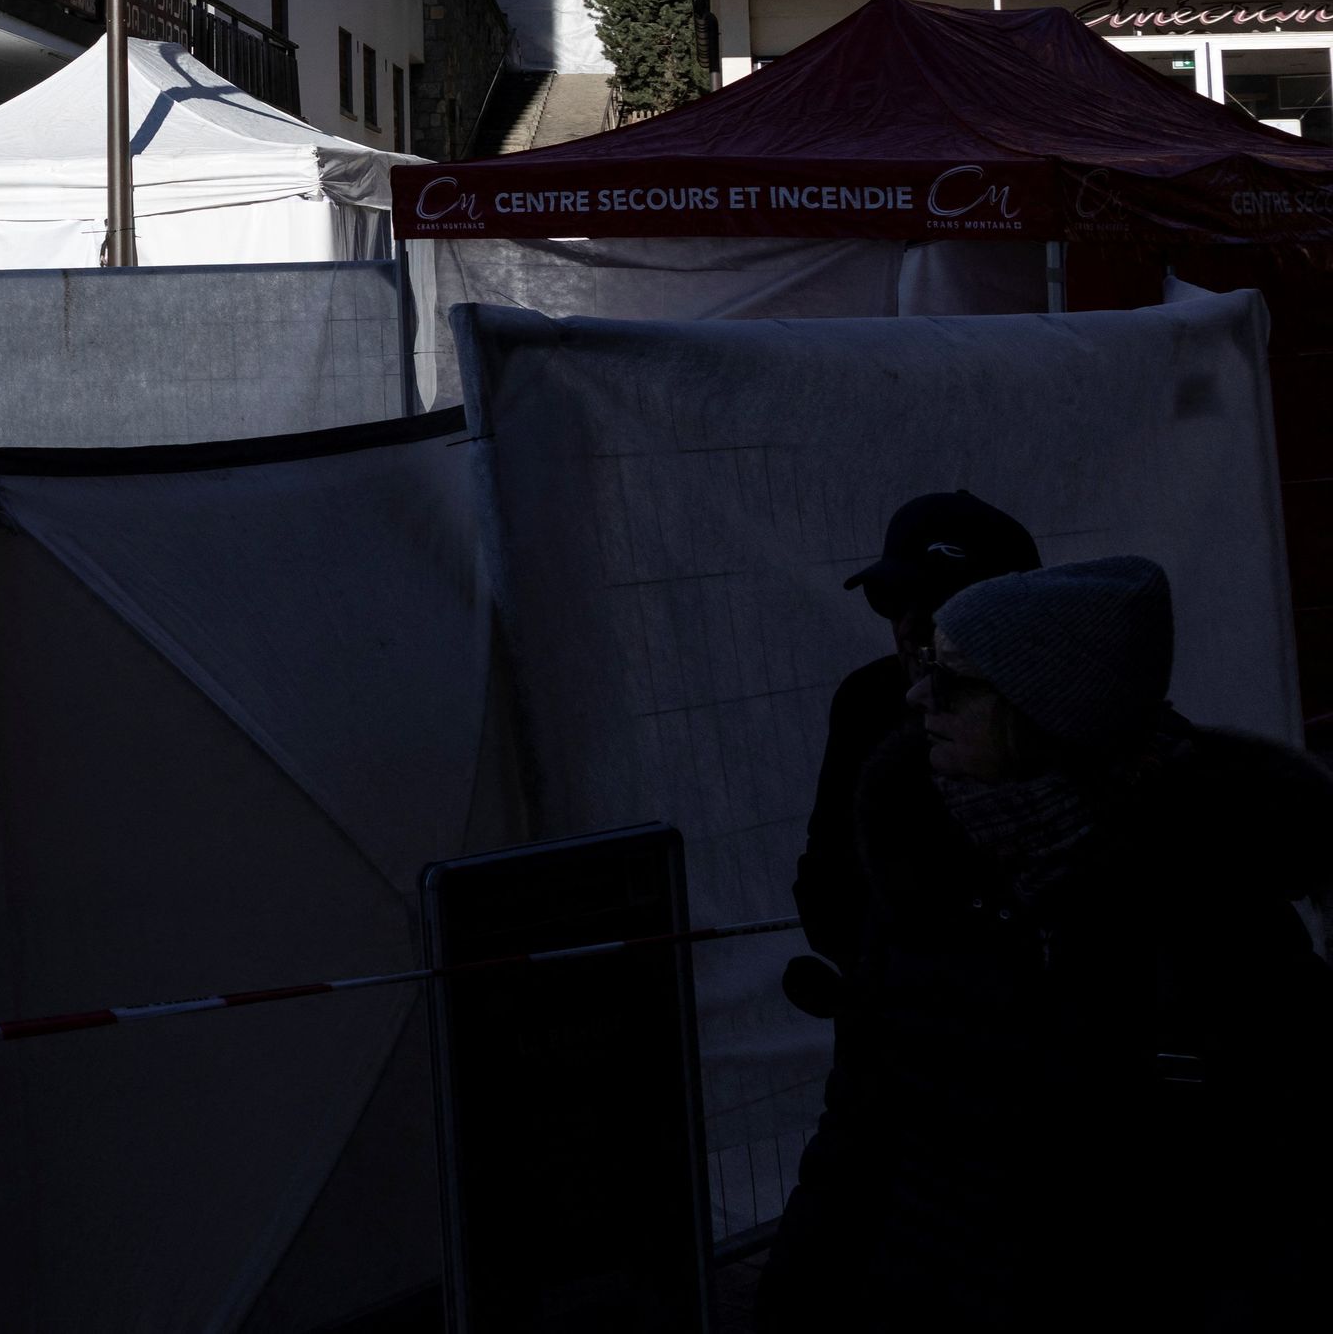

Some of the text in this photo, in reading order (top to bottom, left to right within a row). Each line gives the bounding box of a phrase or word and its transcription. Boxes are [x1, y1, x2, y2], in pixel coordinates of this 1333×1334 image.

[495, 186, 914, 214] CENTRE SECOURS ET INCENDIE
[1231, 190, 1292, 215] CENTRE
[926, 220, 1012, 230] CRANS MONTANA
